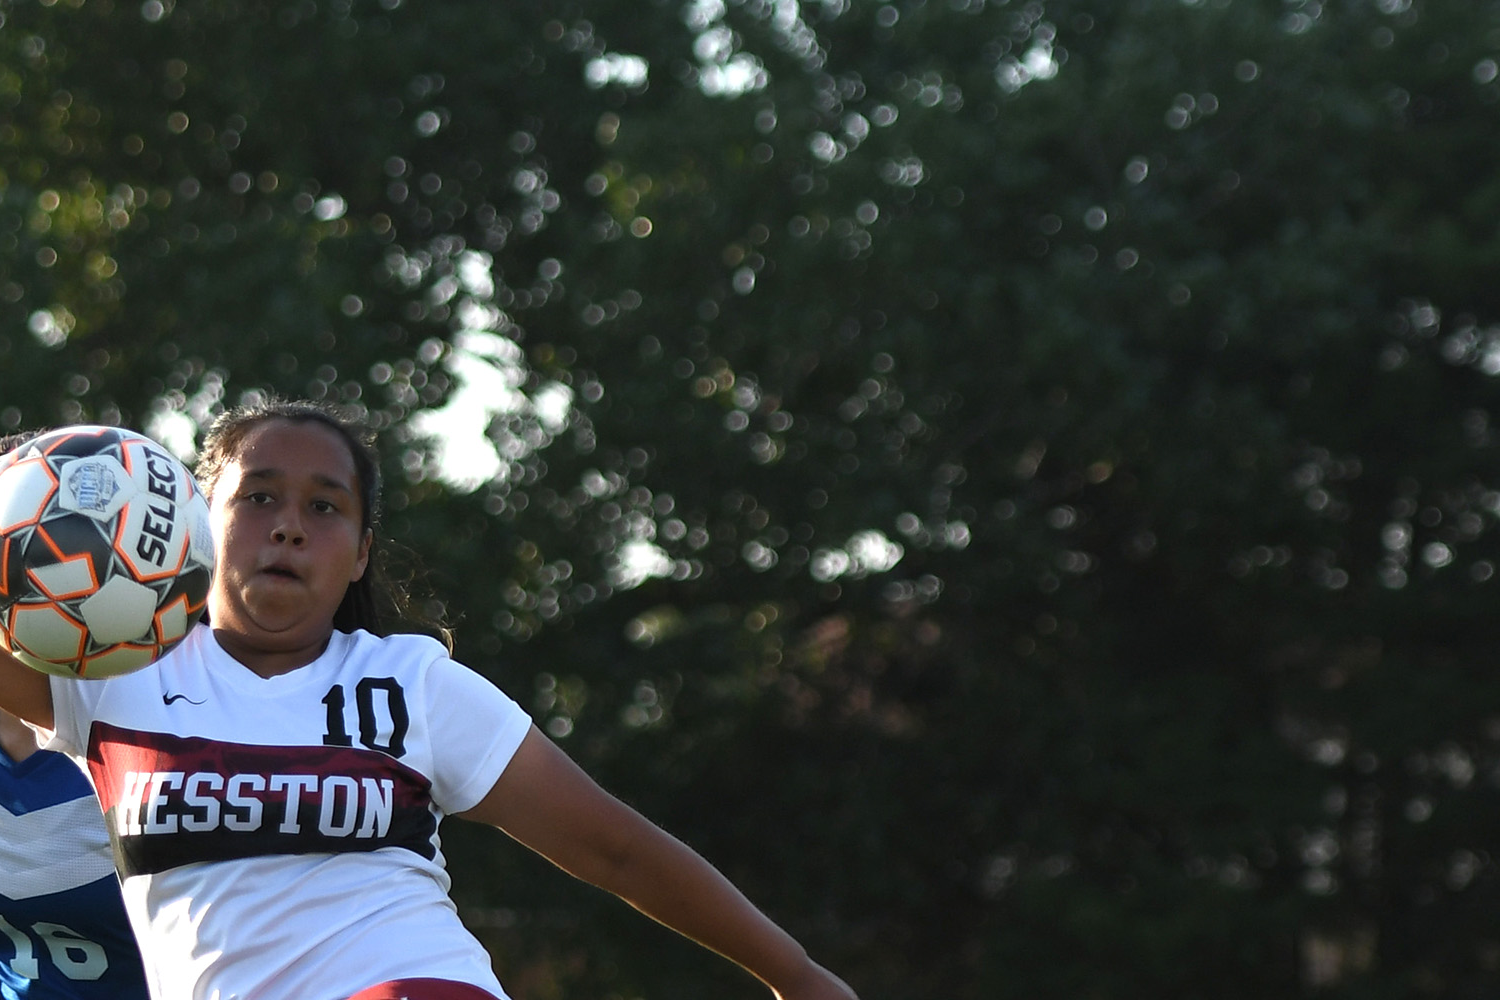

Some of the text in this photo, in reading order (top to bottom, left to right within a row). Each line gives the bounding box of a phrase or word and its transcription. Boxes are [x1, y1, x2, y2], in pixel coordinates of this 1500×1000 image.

[137, 447, 176, 568] SELECT
[321, 676, 410, 760] 10
[118, 770, 395, 840] HESSTON
